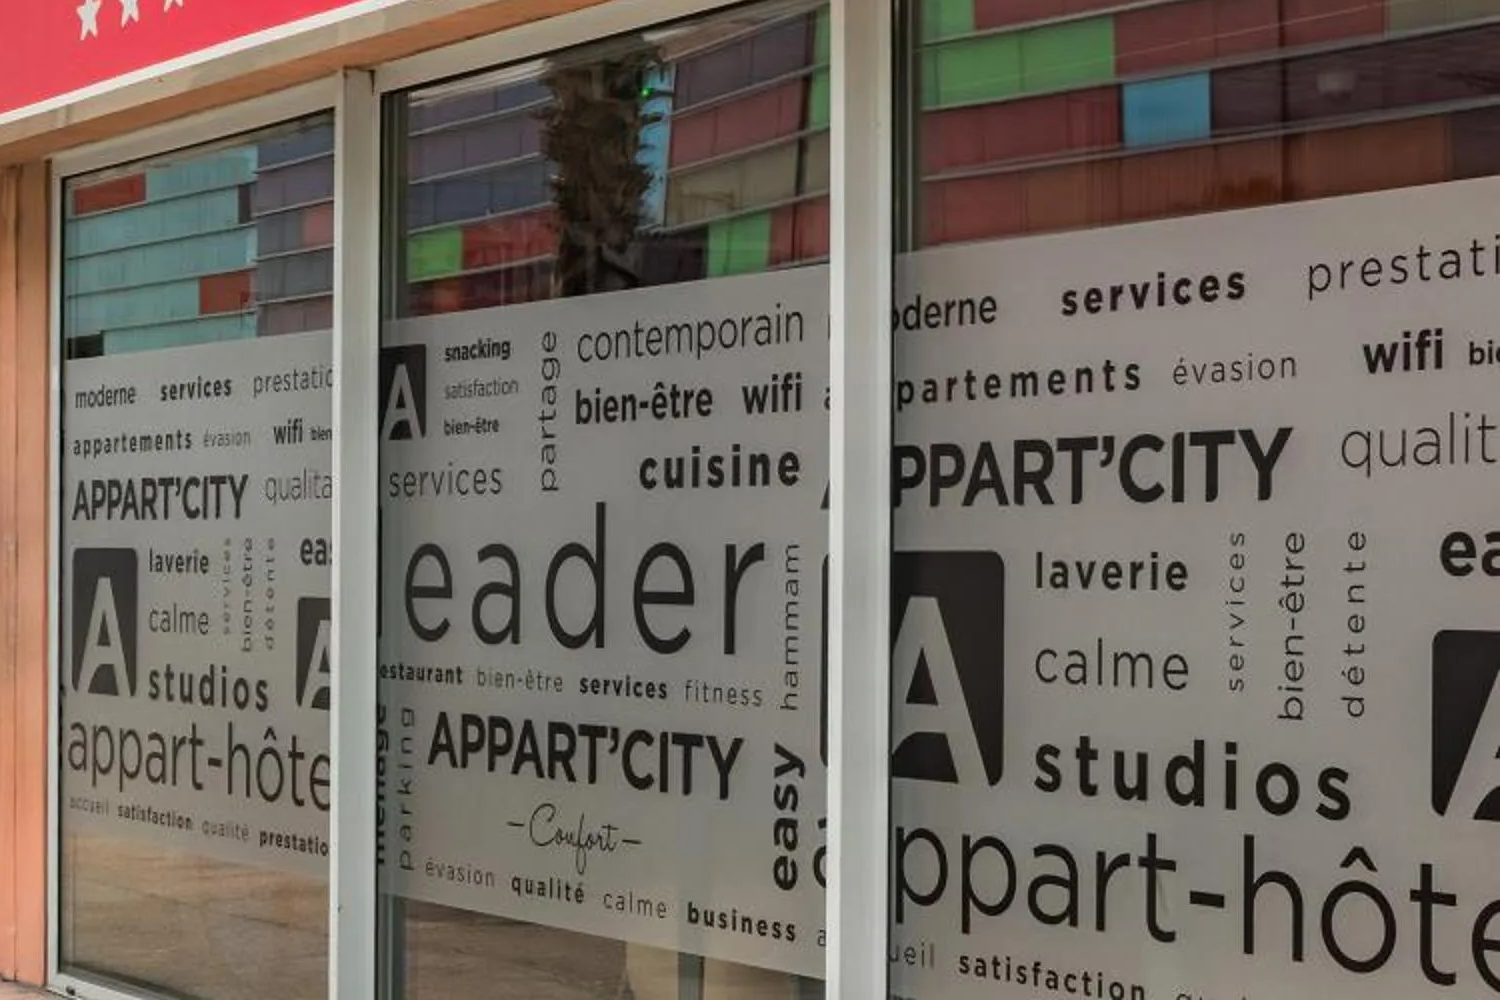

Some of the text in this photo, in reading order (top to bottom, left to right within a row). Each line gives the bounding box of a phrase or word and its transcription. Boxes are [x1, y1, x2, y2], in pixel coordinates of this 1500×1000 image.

[1061, 270, 1246, 316] services
[444, 338, 511, 361] snacking
[577, 303, 803, 362] contemporain
[1172, 352, 1297, 386] évasion
[1363, 327, 1443, 374] wifi
[75, 384, 136, 408] moderne
[160, 376, 232, 401] services
[444, 377, 519, 399] satisfaction
[575, 372, 802, 425] bien-être wifi
[444, 416, 500, 436] bien-être
[538, 331, 560, 492] partage
[73, 430, 192, 458] appartements
[203, 428, 251, 448] évasion
[273, 418, 303, 444] wifi
[388, 461, 503, 498] services
[639, 444, 800, 490] cuisine
[893, 427, 1293, 508] PPART'CITY
[72, 474, 249, 520] APPART'CITY
[149, 548, 209, 575] laverie
[300, 537, 332, 566] ea
[1035, 552, 1189, 591] laverie
[149, 603, 209, 636] calme
[780, 544, 799, 711] hammam
[1227, 532, 1245, 692] services
[1277, 532, 1305, 721] bien-être
[477, 665, 563, 693] bien-être
[579, 677, 667, 701] services
[685, 680, 763, 707] fitness
[1035, 638, 1190, 691] calme
[148, 664, 269, 712] studios
[428, 711, 744, 799] APPART'CITY
[1034, 735, 1351, 821] studios
[117, 804, 193, 829] satisfaction
[201, 819, 250, 842] qualité
[773, 743, 805, 891] easy
[425, 857, 796, 942] évasion qualité calme business
[958, 953, 1145, 1000] satisfaction
